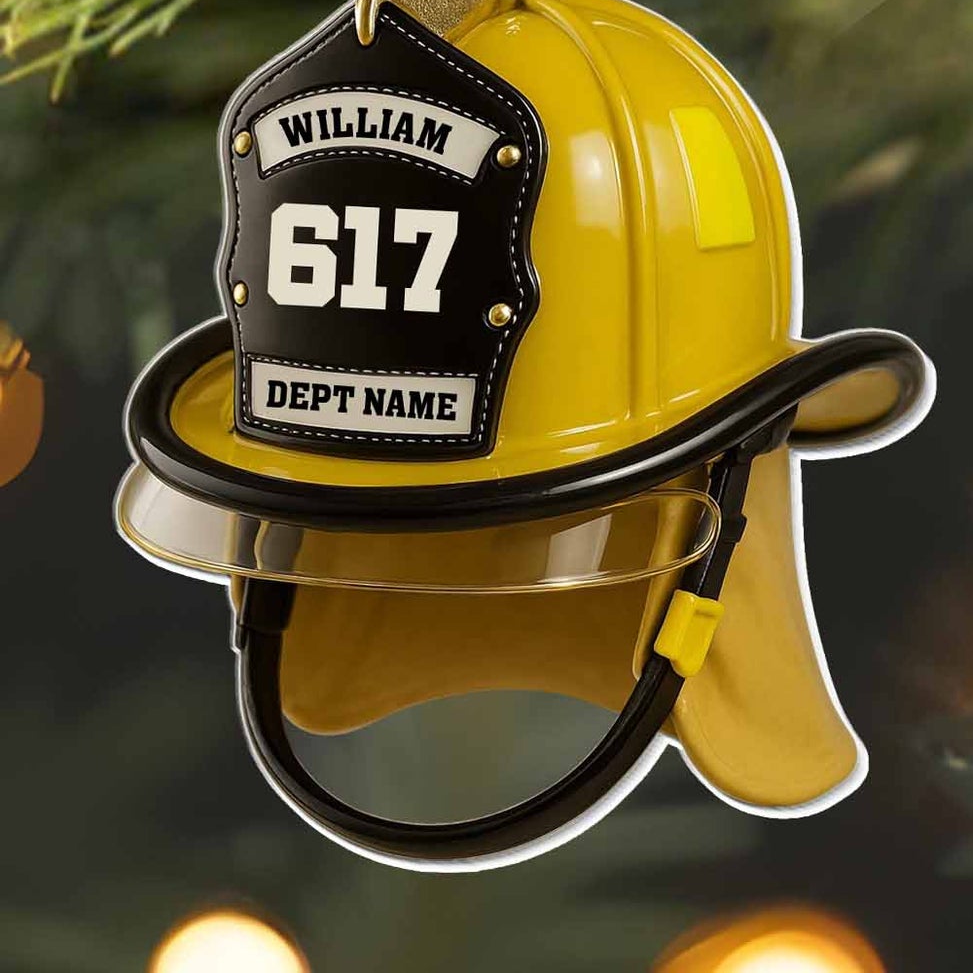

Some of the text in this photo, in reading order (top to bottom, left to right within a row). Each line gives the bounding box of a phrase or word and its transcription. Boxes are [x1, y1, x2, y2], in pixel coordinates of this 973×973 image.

[278, 106, 453, 156] WILLIAM
[267, 202, 459, 313] 617
[265, 379, 458, 422] DEPT NAME
